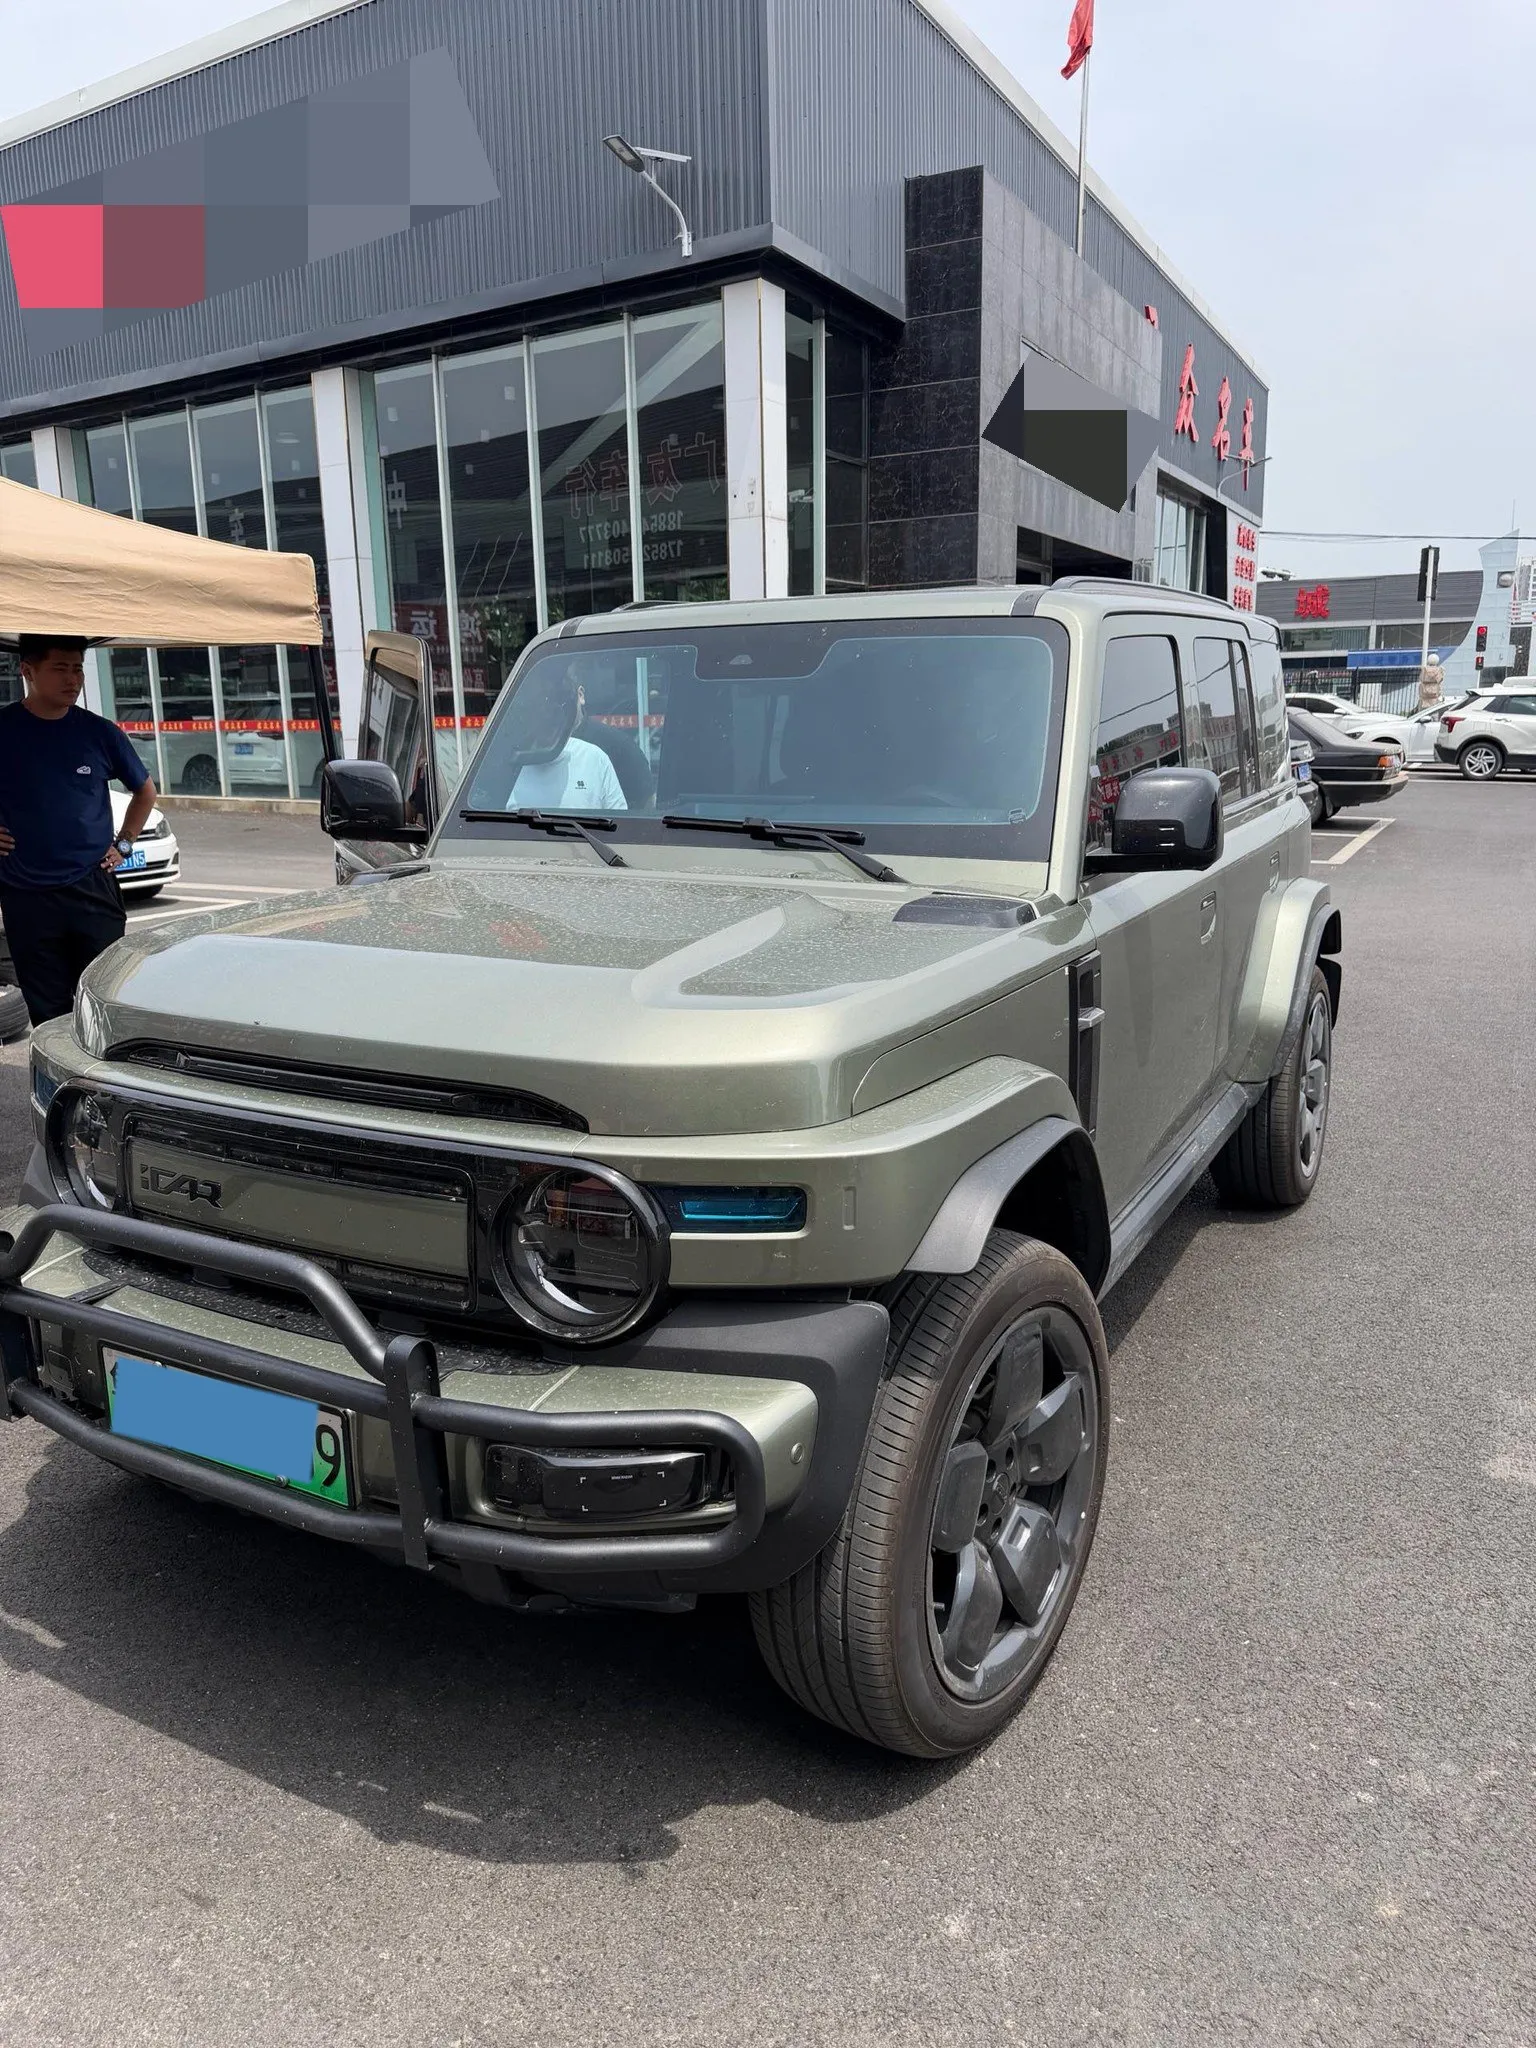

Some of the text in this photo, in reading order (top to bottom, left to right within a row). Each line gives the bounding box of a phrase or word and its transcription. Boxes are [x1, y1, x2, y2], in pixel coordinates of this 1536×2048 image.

[1144, 304, 1255, 492] 众名车
[1294, 584, 1330, 620] 城
[140, 1163, 224, 1210] iCAR
